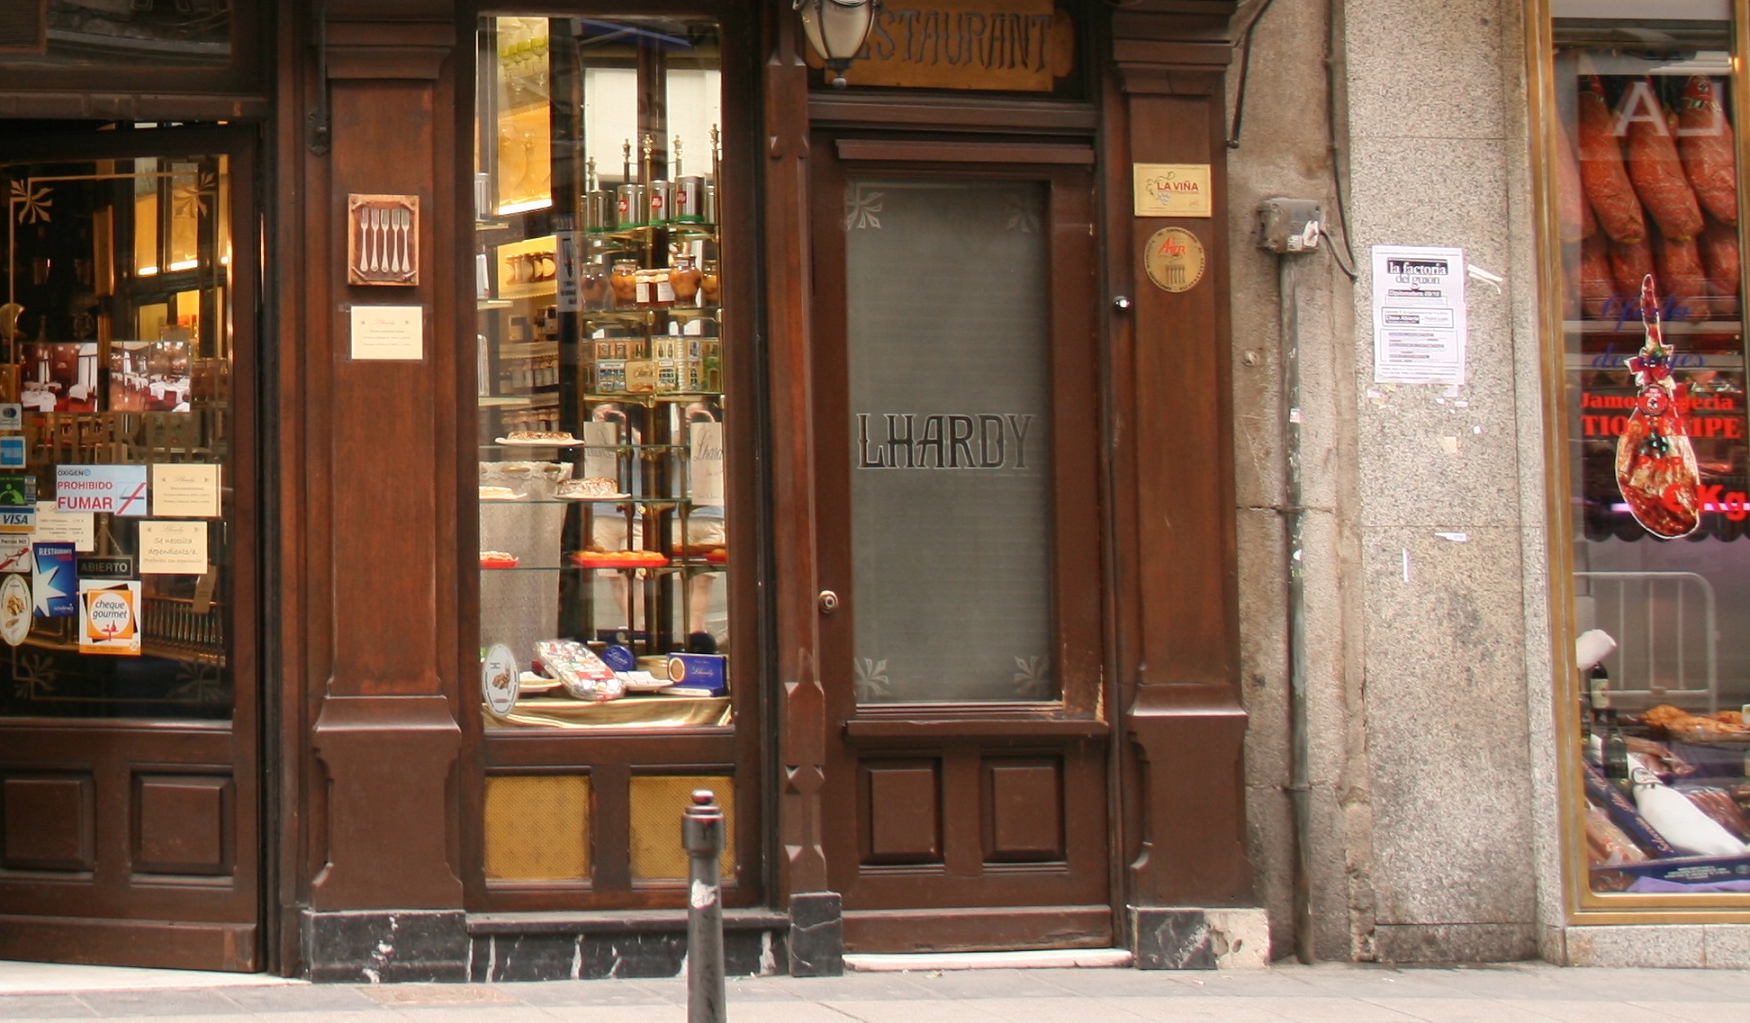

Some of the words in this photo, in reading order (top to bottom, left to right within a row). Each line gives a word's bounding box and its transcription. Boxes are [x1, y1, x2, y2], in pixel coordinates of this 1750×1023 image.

[857, 9, 1054, 73] STAURANT
[1157, 181, 1172, 191] LA
[1173, 180, 1199, 191] VIÑA
[1389, 262, 1399, 274] la
[1402, 262, 1447, 276] factoria
[1395, 274, 1410, 284] del
[1602, 294, 1690, 332] Ofeta
[1579, 392, 1640, 409] Jamo
[1580, 415, 1629, 436] TIO
[856, 412, 1036, 470] LHARDY
[57, 496, 113, 510] FUMAR
[1696, 484, 1748, 521] Kg
[2, 514, 29, 525] VISA
[81, 562, 128, 572] ABIERTO
[94, 599, 126, 611] cheque
[92, 609, 128, 620] gourmet
